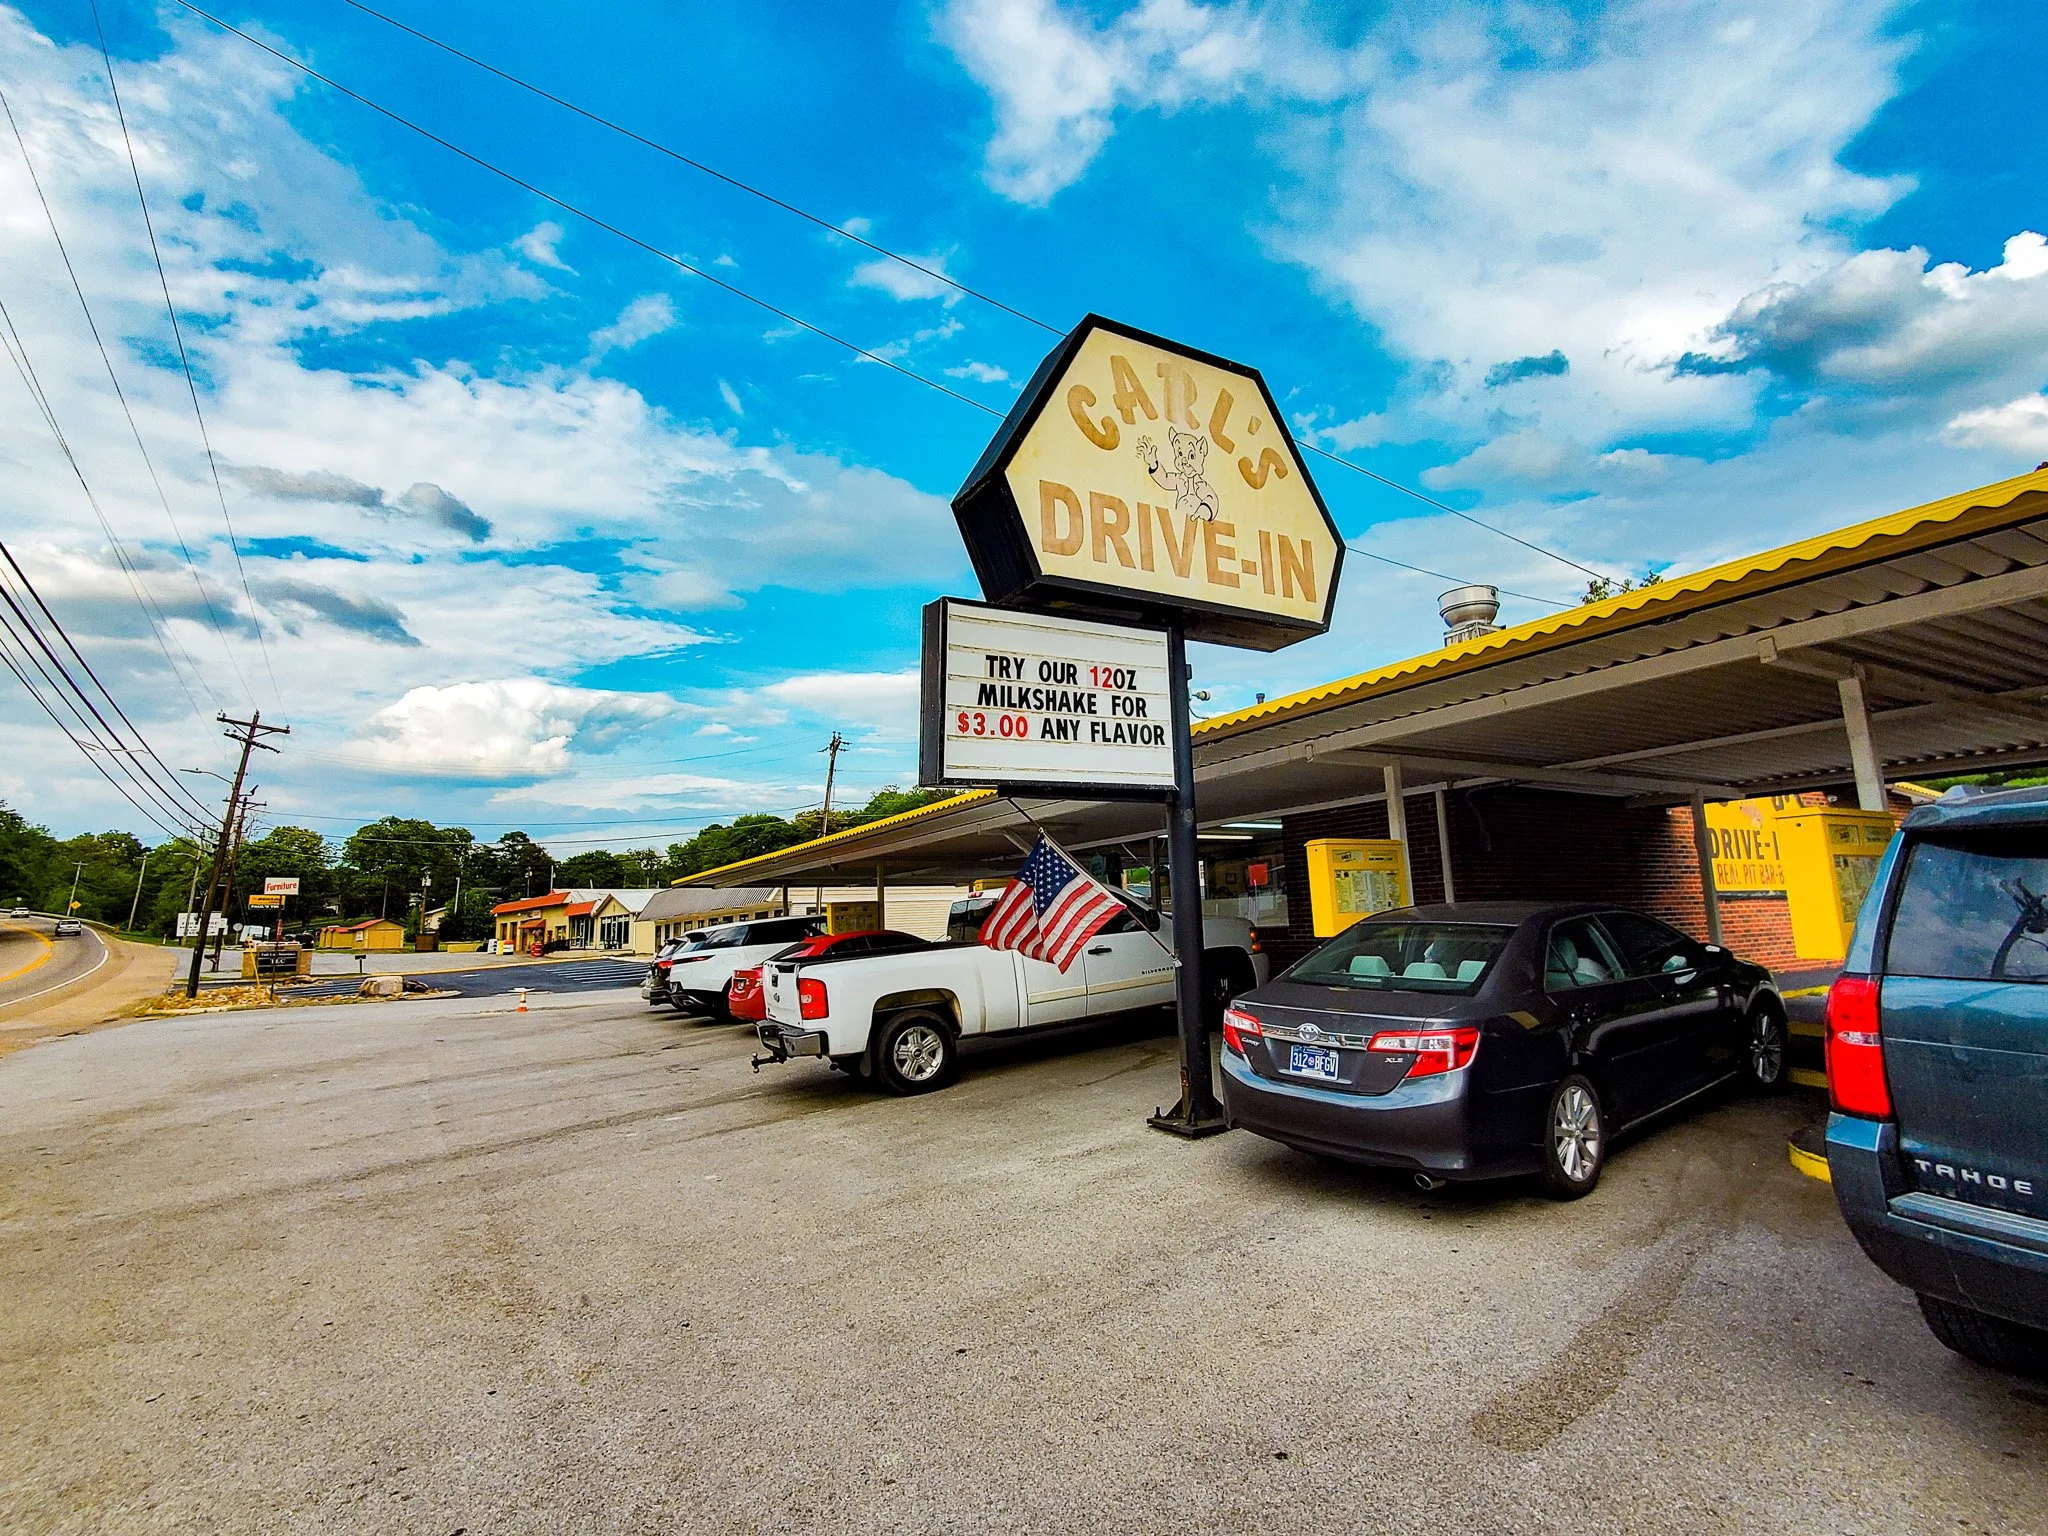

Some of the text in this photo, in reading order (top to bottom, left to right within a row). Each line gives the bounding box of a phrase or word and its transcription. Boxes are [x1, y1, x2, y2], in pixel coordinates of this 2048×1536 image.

[1067, 355, 1289, 490] CARL'S
[1039, 479, 1317, 604] DRIVE-IN
[985, 655, 1137, 690] TRY OUR 12OZ
[977, 683, 1148, 718] MILKSHAKE FOR
[957, 711, 1166, 746] $3.00 ANY FLAVOR
[1707, 827, 1780, 861] DRIVE-I
[266, 881, 298, 892] Furniture
[1716, 863, 1742, 885] REAL
[1743, 863, 1757, 885] PIT
[1292, 1052, 1309, 1068] 312
[1914, 1159, 2034, 1196] TAHOE
